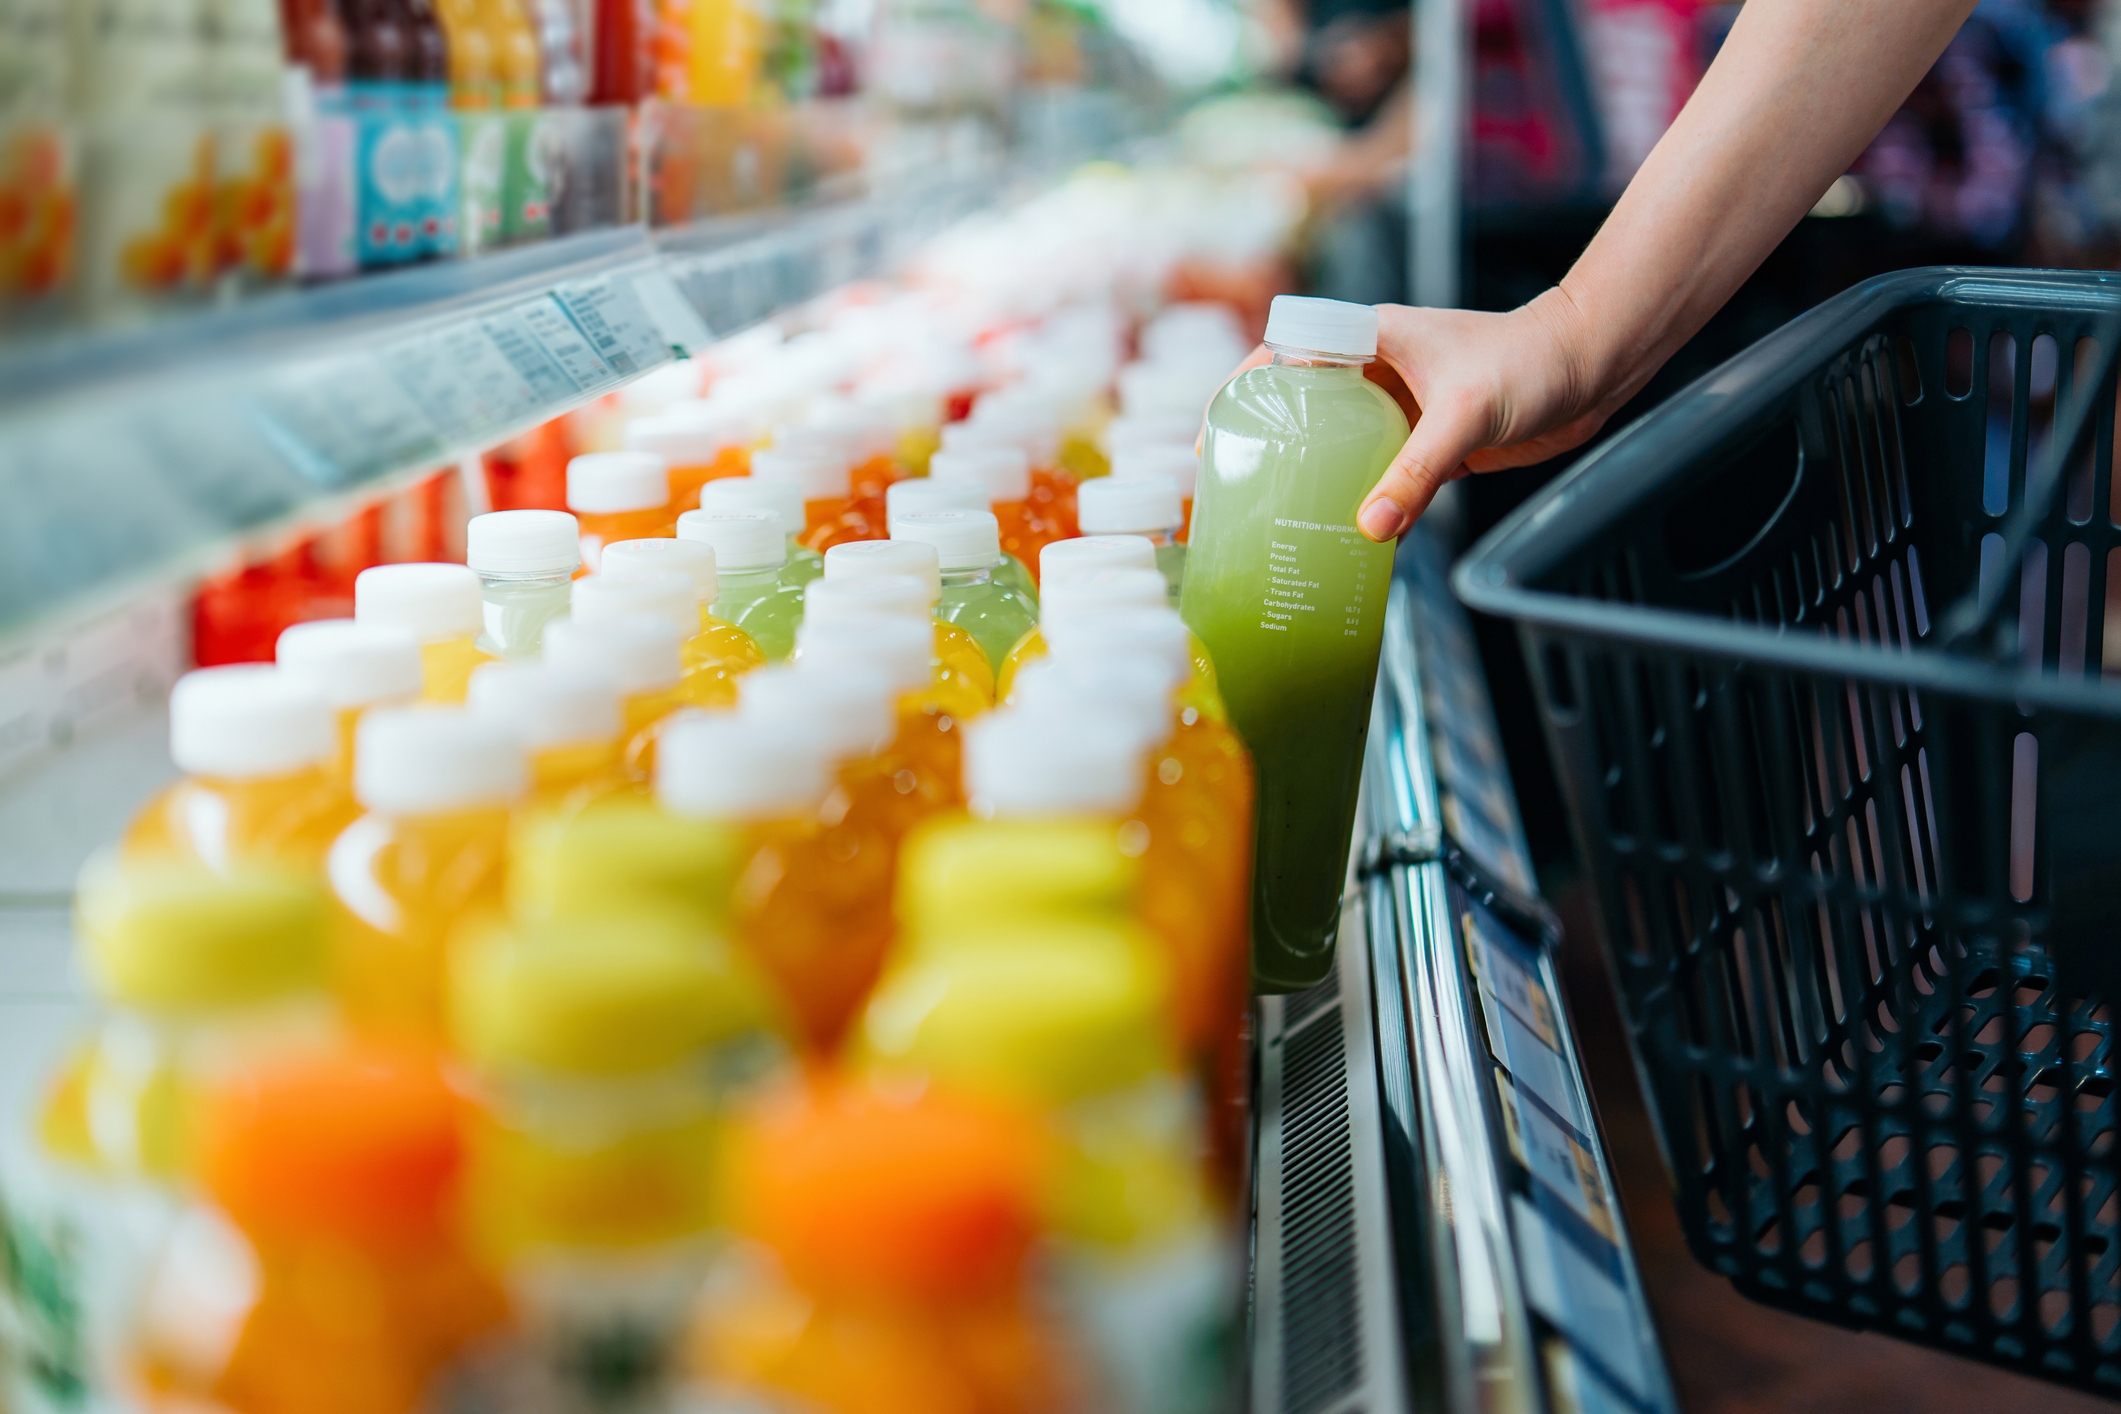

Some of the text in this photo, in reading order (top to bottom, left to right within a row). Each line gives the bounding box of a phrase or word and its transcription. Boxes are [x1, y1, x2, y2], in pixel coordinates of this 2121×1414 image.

[1275, 518, 1358, 533] NUTRITION INFORMA
[1271, 541, 1297, 552] Energy
[1270, 552, 1297, 563] Protein
[1269, 564, 1300, 575] Total Fat
[1271, 576, 1307, 588] Saturated
[1308, 581, 1320, 589] Fat
[1270, 588, 1291, 597] Trans
[1292, 591, 1304, 599] Fat
[1263, 599, 1316, 612] Carbohydrates
[1267, 611, 1293, 621] Sugars
[1260, 621, 1287, 631] Sodium
